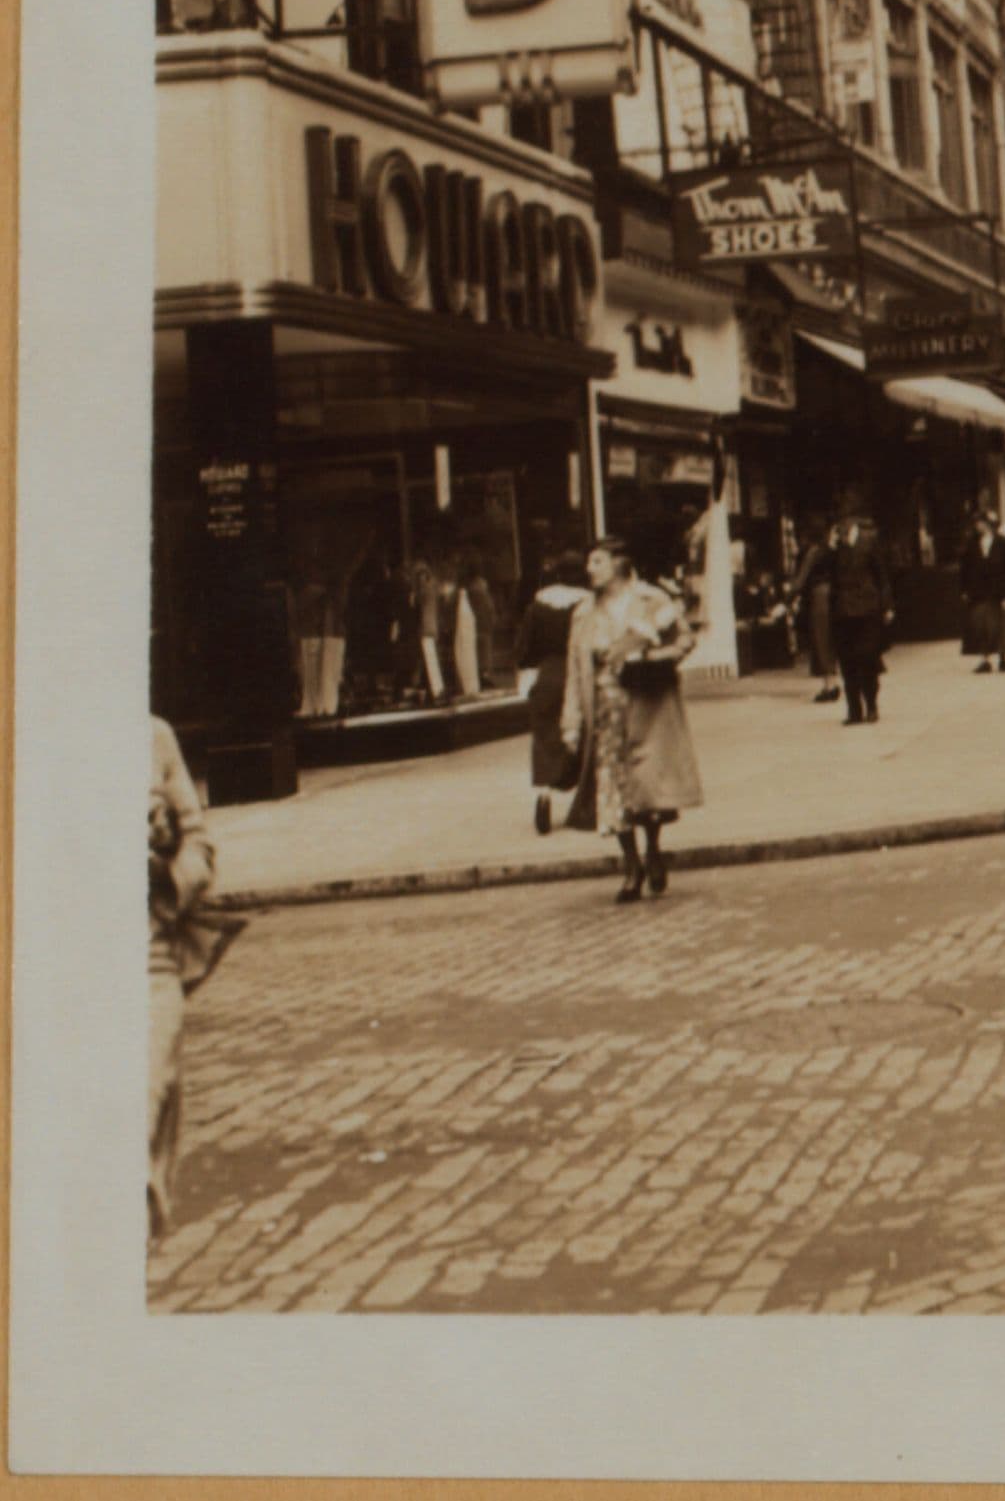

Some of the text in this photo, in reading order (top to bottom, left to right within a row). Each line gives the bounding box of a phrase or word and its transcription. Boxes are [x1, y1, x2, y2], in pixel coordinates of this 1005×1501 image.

[679, 176, 772, 226] Thom
[304, 125, 600, 342] HOWARD
[711, 218, 817, 256] SHOES
